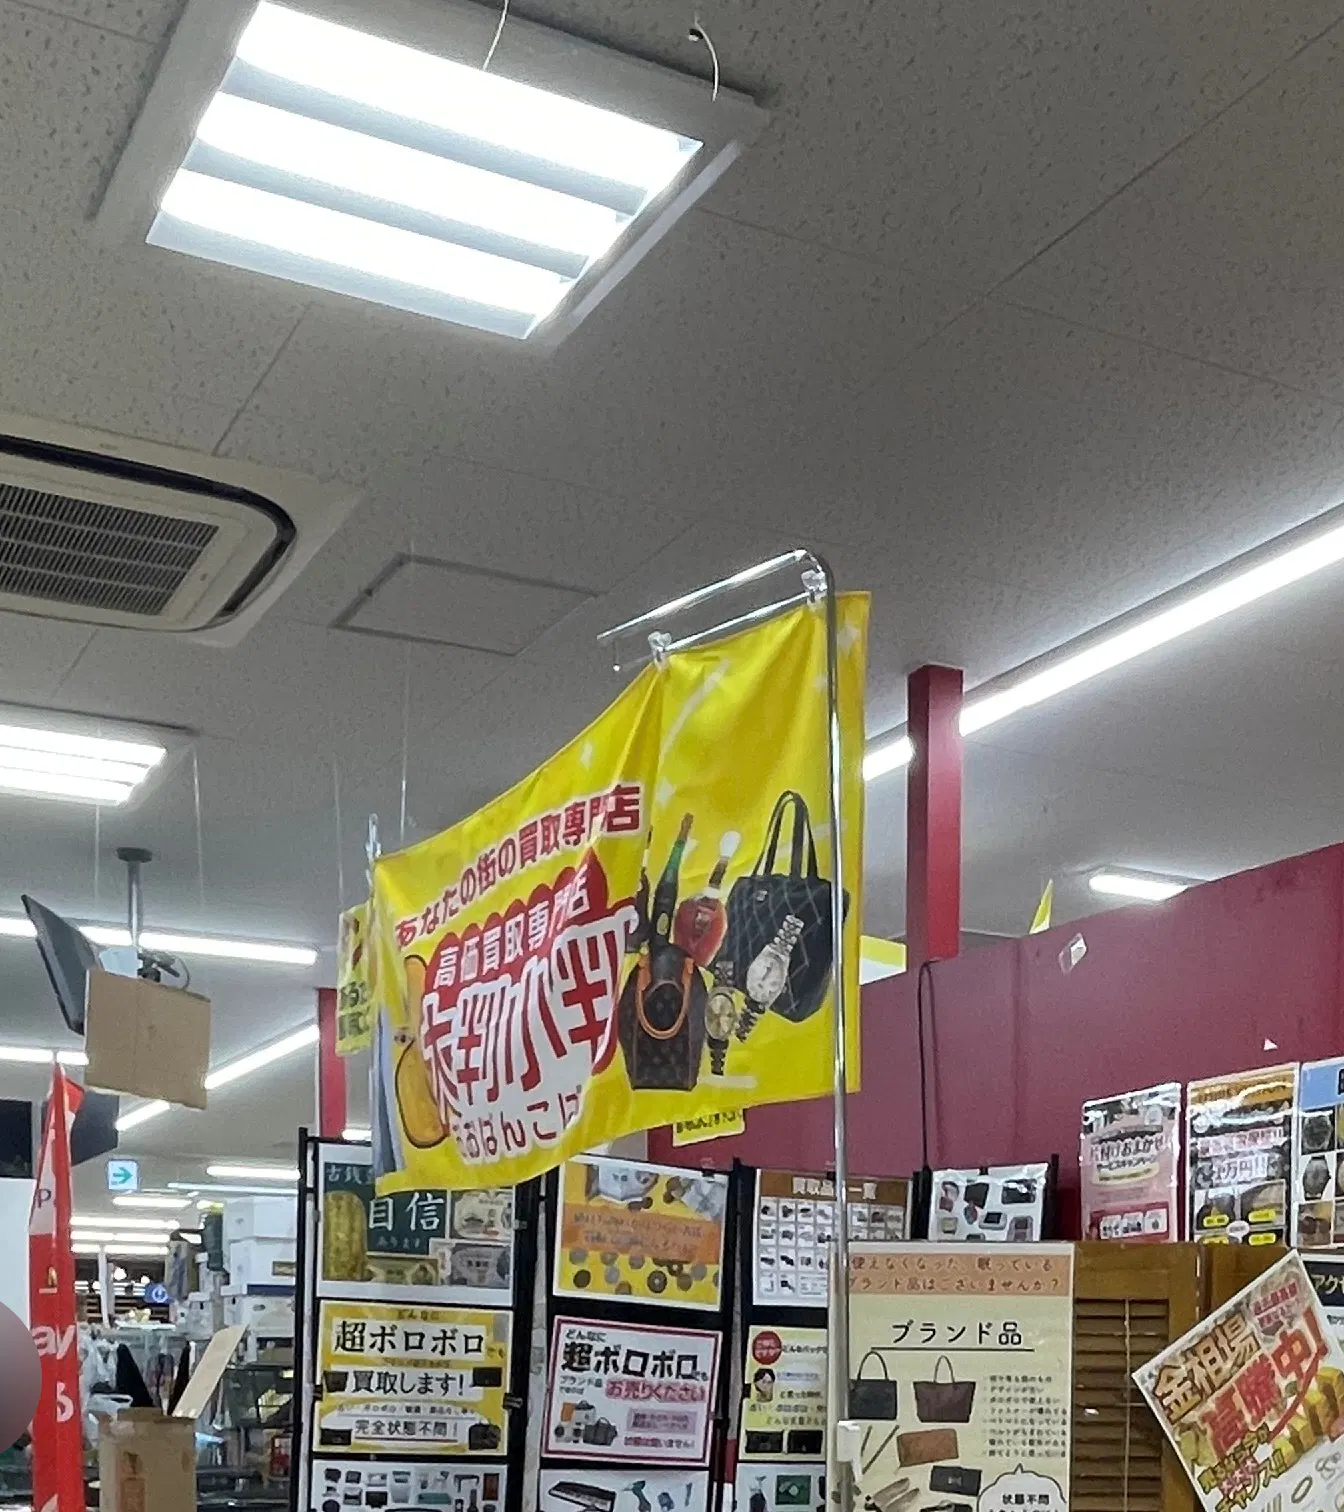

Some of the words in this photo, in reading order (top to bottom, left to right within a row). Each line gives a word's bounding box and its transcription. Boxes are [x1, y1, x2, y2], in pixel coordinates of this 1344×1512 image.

[395, 785, 640, 946] あなたの街の買取専門店
[434, 864, 590, 989] 高価買取専門店
[368, 1192, 444, 1232] 自信
[335, 1320, 484, 1356] 超ボロボロ
[566, 1328, 607, 1342] どんなに
[892, 1319, 1023, 1346] ブランド品
[561, 1340, 698, 1380] 超ボロボロ
[1156, 1309, 1263, 1427] 金相場
[352, 1370, 464, 1397] 買取します!
[606, 1379, 706, 1402] お売りください
[1002, 1494, 1050, 1506] 状態不問
